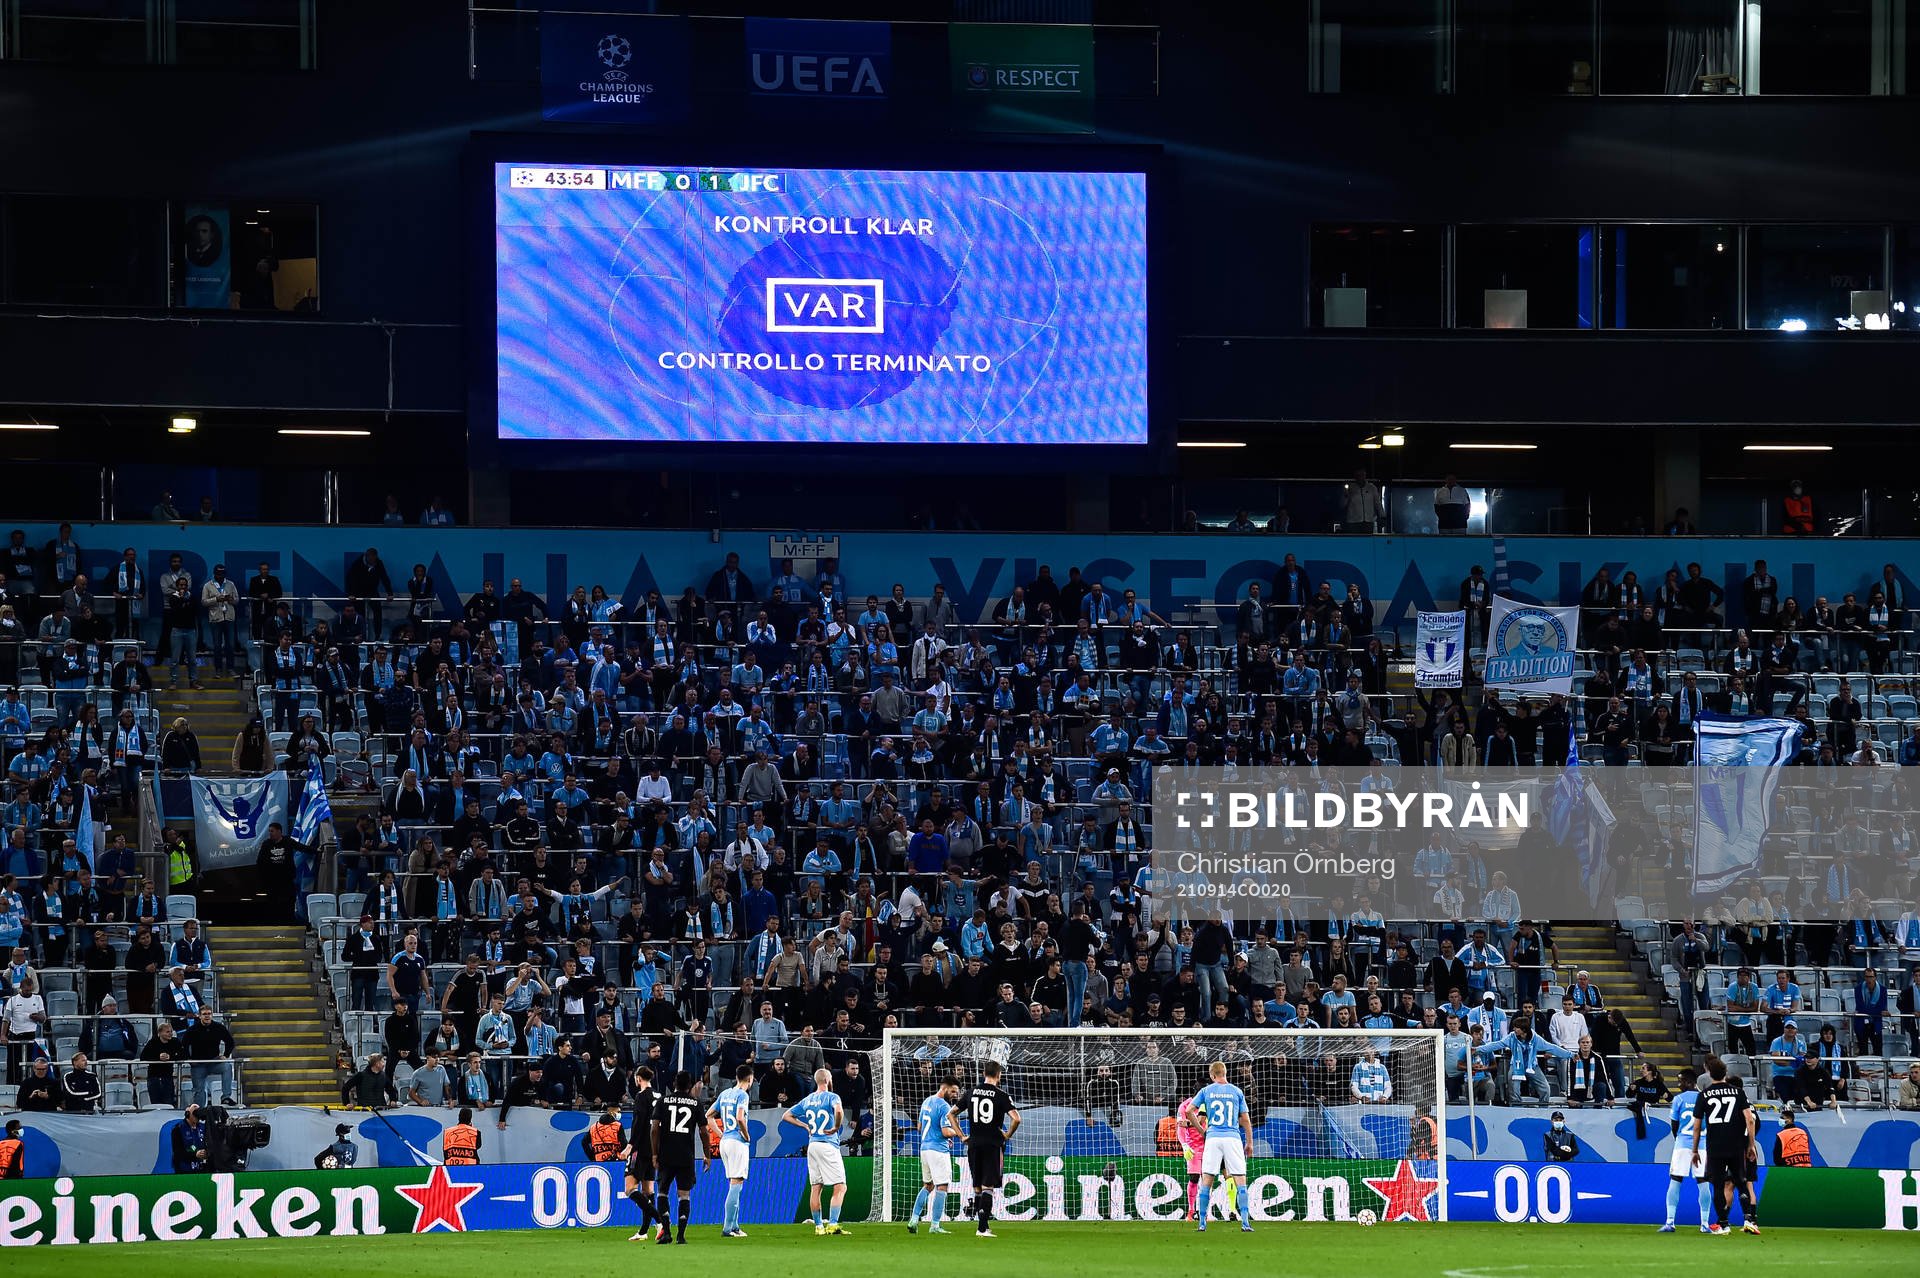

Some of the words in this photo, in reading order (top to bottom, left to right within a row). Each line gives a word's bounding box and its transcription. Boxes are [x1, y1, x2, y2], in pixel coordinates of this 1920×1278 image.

[752, 53, 884, 93] UEFA
[996, 69, 1080, 87] RESPECT
[579, 81, 654, 94] CHAMPIONS
[592, 93, 641, 104] LEAGUE
[544, 172, 594, 186] 43:54
[611, 173, 660, 190] MFF
[675, 174, 690, 190] 0
[709, 175, 719, 190] 1
[738, 174, 779, 191] JFC
[714, 215, 858, 235] KONTROLL
[867, 217, 934, 236] KLAR
[783, 292, 866, 318] VAR
[657, 351, 825, 371] CONTROLLO
[831, 354, 991, 373] TERMINATO
[1490, 656, 1570, 679] TRADITION
[238, 819, 250, 835] 5
[663, 1096, 677, 1104] ALEX
[1703, 1087, 1739, 1098] LOCATELLI
[667, 1104, 692, 1133] 12
[721, 1105, 737, 1131] 15
[970, 1096, 994, 1124] 19
[1210, 1100, 1234, 1127] 31
[1707, 1096, 1737, 1124] 27
[805, 1109, 830, 1135] 32
[0, 1173, 387, 1246] eineken
